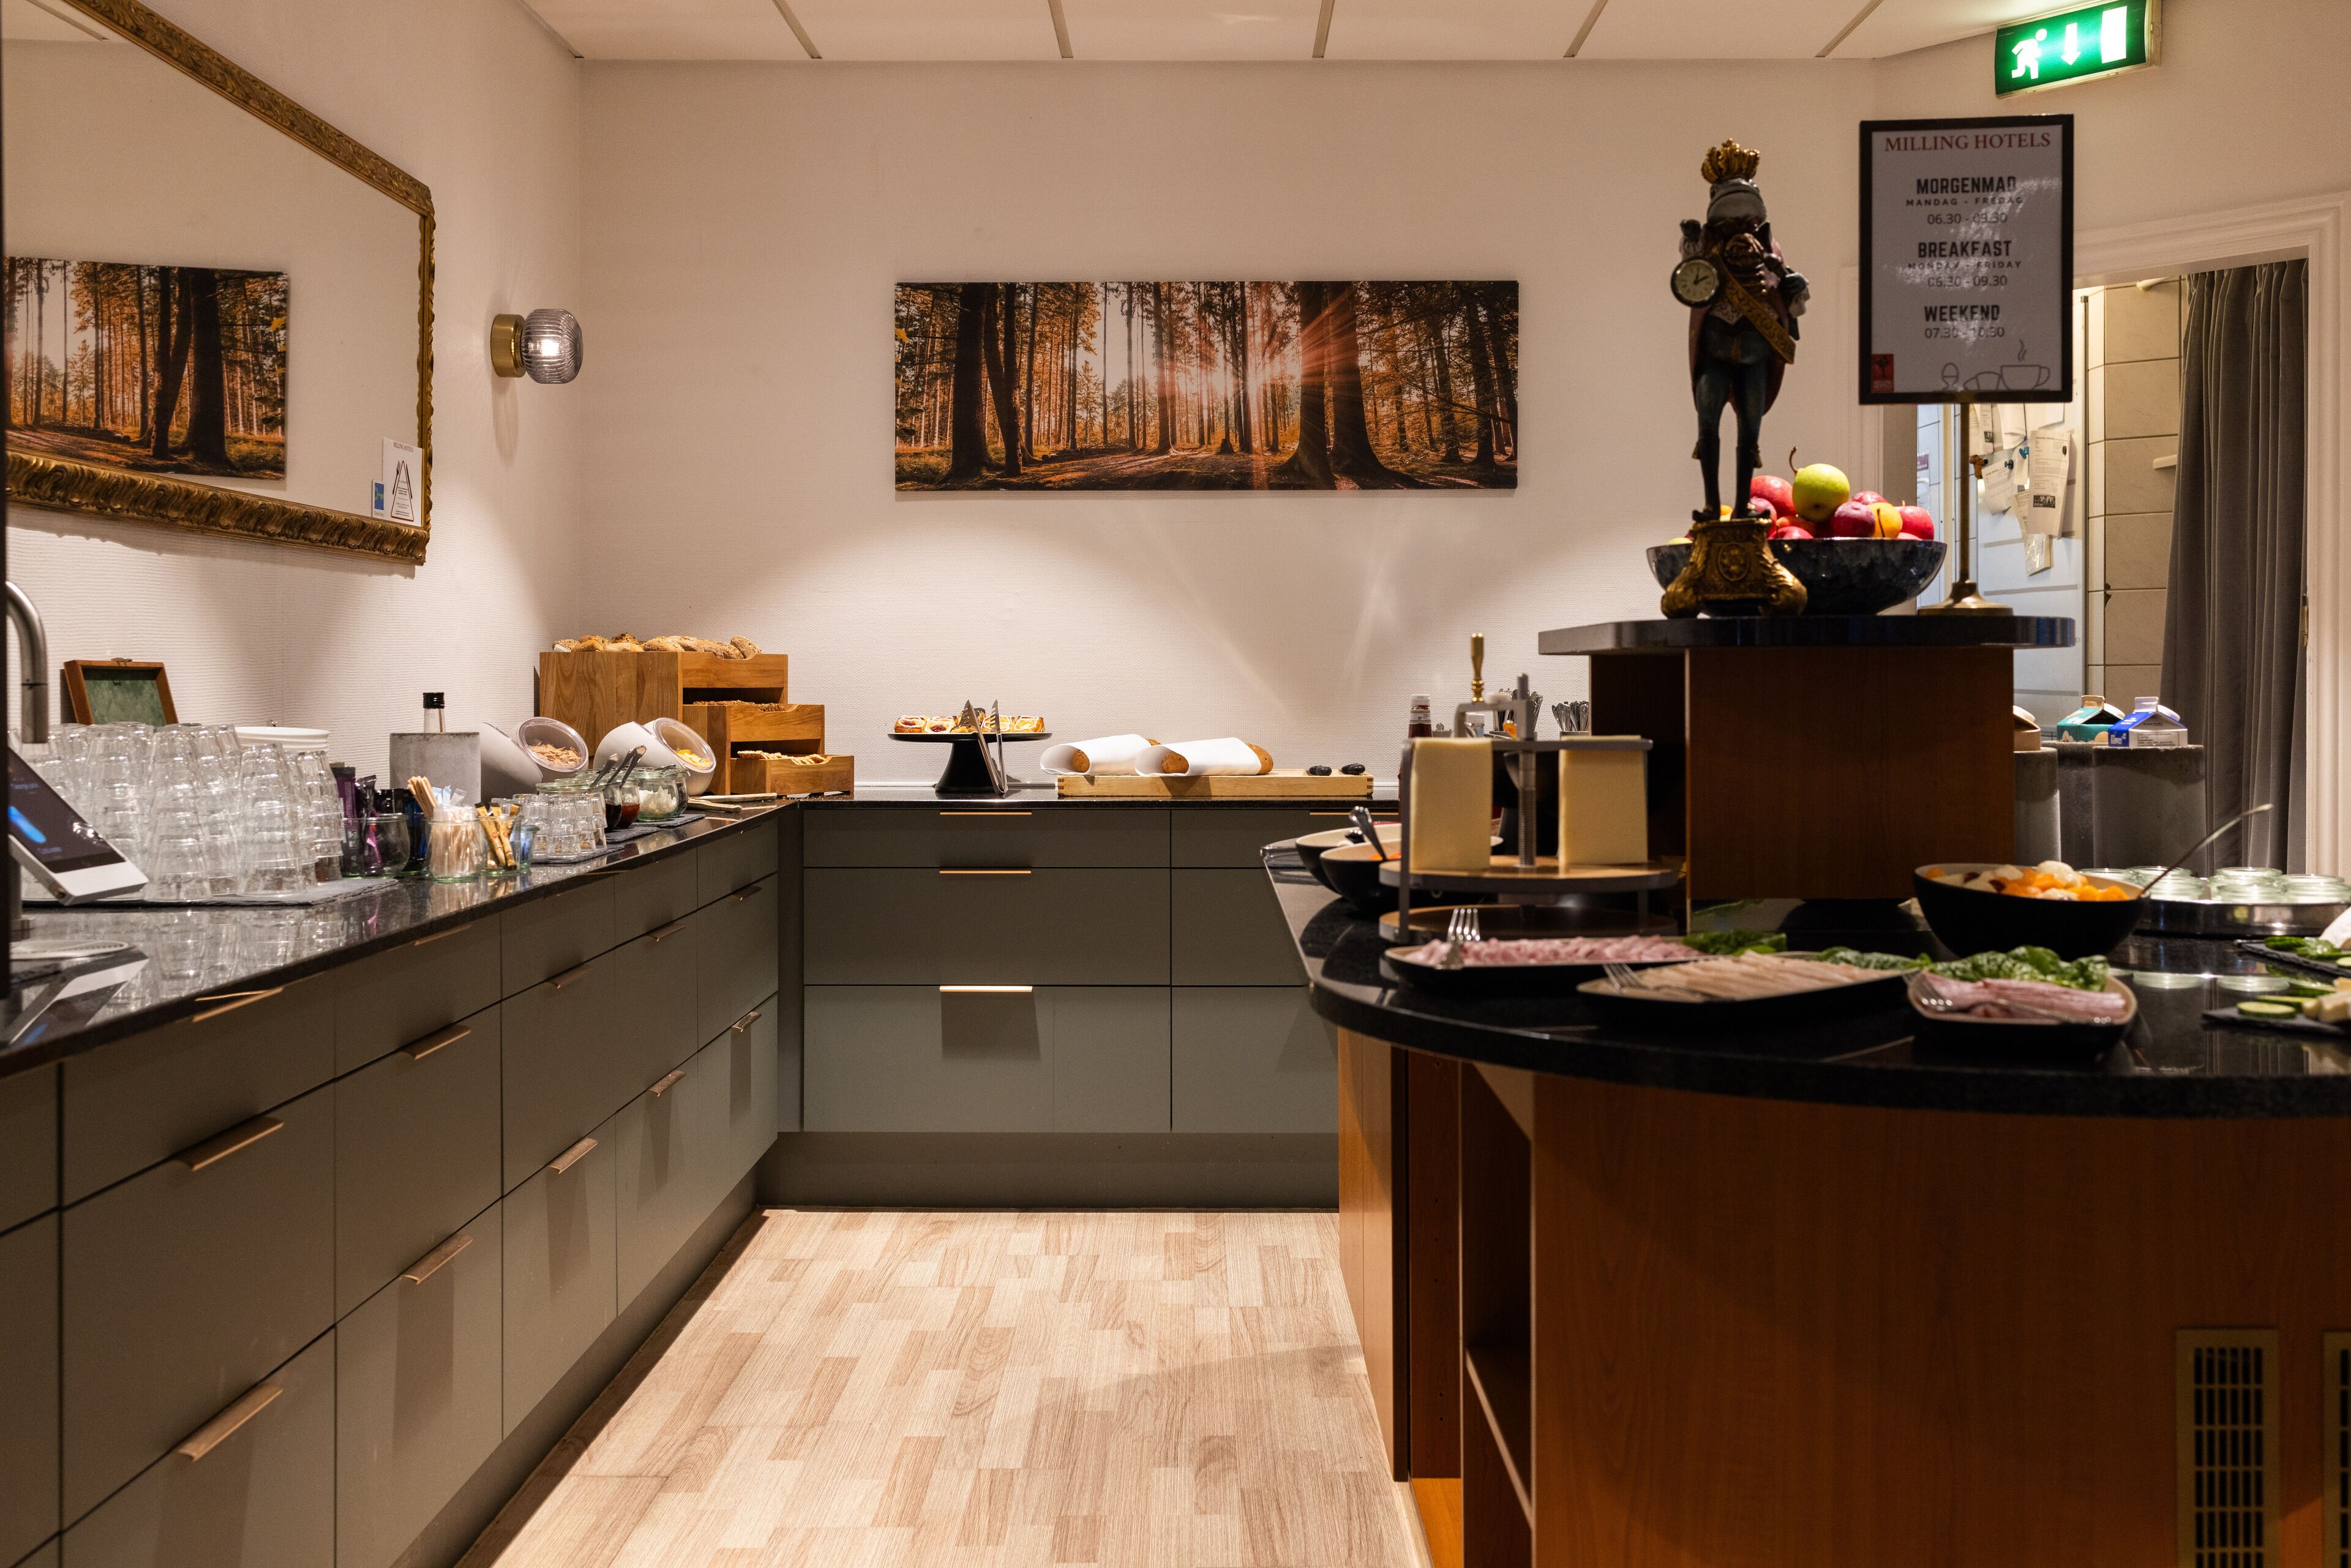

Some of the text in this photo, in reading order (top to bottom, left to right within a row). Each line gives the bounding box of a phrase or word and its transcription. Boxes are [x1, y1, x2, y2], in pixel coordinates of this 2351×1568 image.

[1885, 133, 2051, 151] MILLING HOTELS
[1916, 176, 2016, 195] MORGENMAD
[1927, 214, 1962, 224] 06.30
[1918, 241, 2012, 258] BREAKFAST
[1973, 276, 2007, 286] 09.30
[1924, 305, 2000, 321] WEEKEND
[1924, 328, 1959, 339] 07.30
[1970, 327, 2004, 337] 10.30
